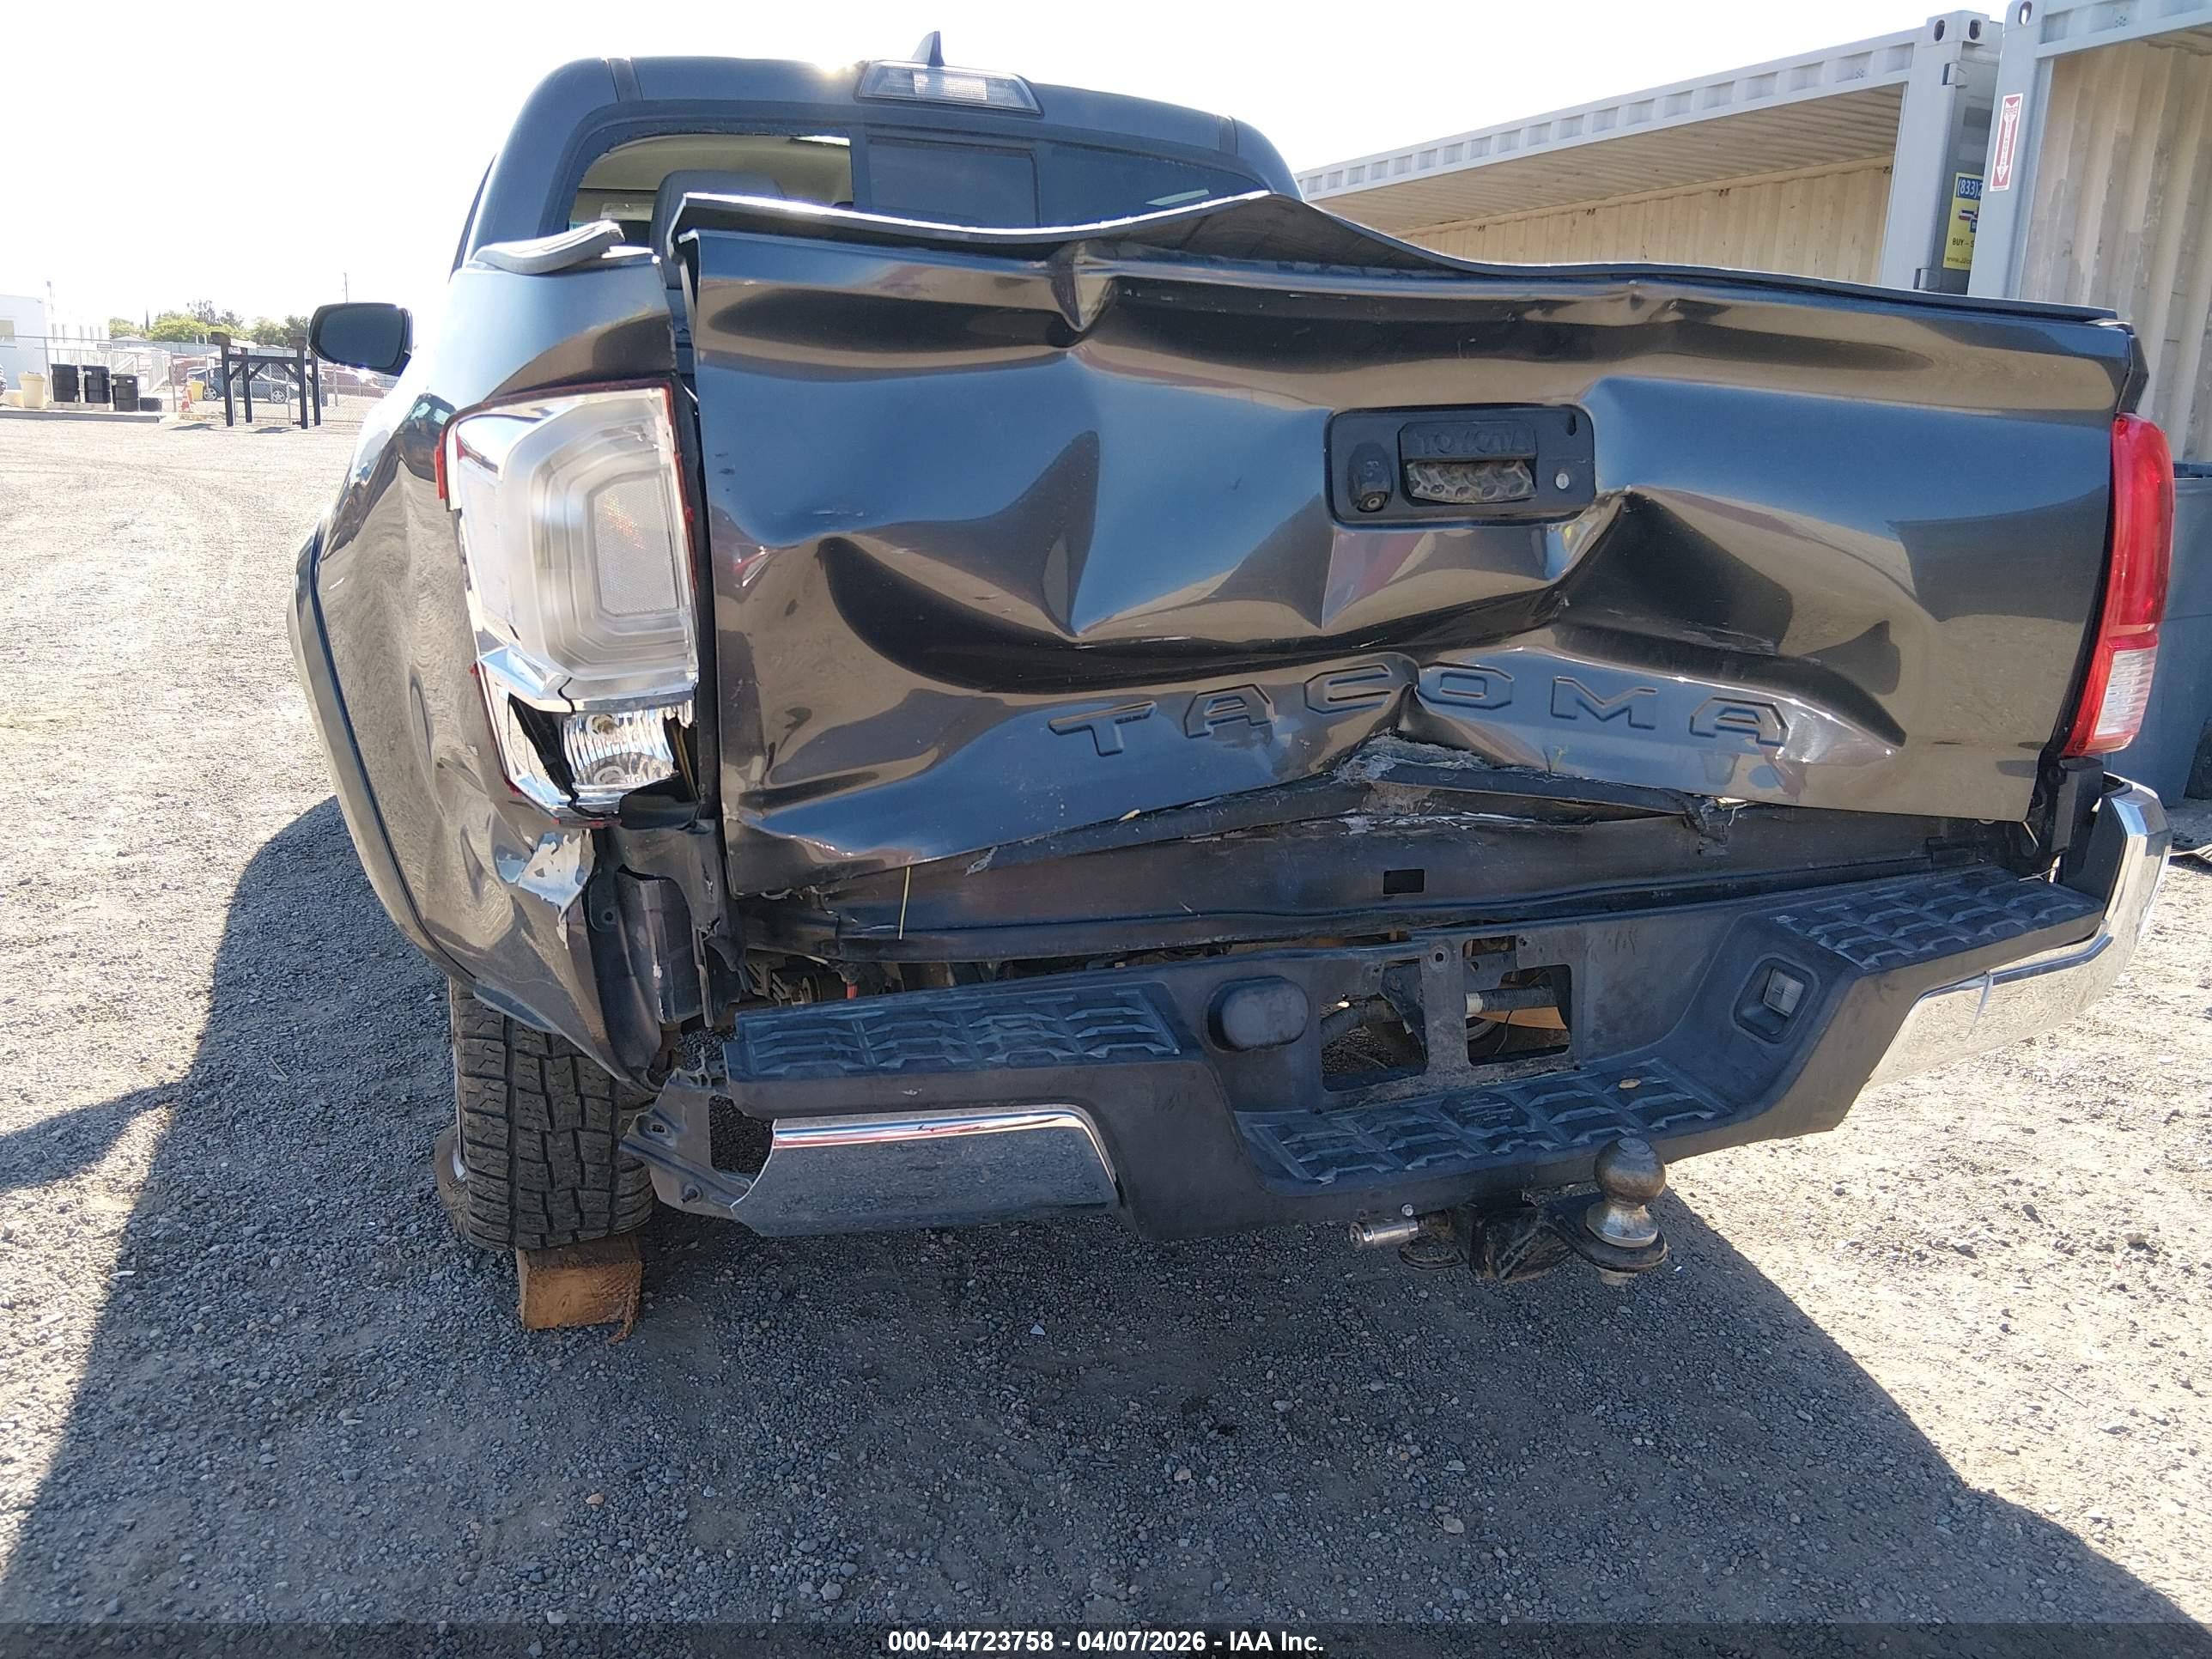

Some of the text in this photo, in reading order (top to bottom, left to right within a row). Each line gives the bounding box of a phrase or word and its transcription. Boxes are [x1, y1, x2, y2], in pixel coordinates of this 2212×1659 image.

[1952, 237, 1965, 246] BUY
[1414, 430, 1528, 454] TOYOTA
[1047, 661, 1789, 757] TACOMA
